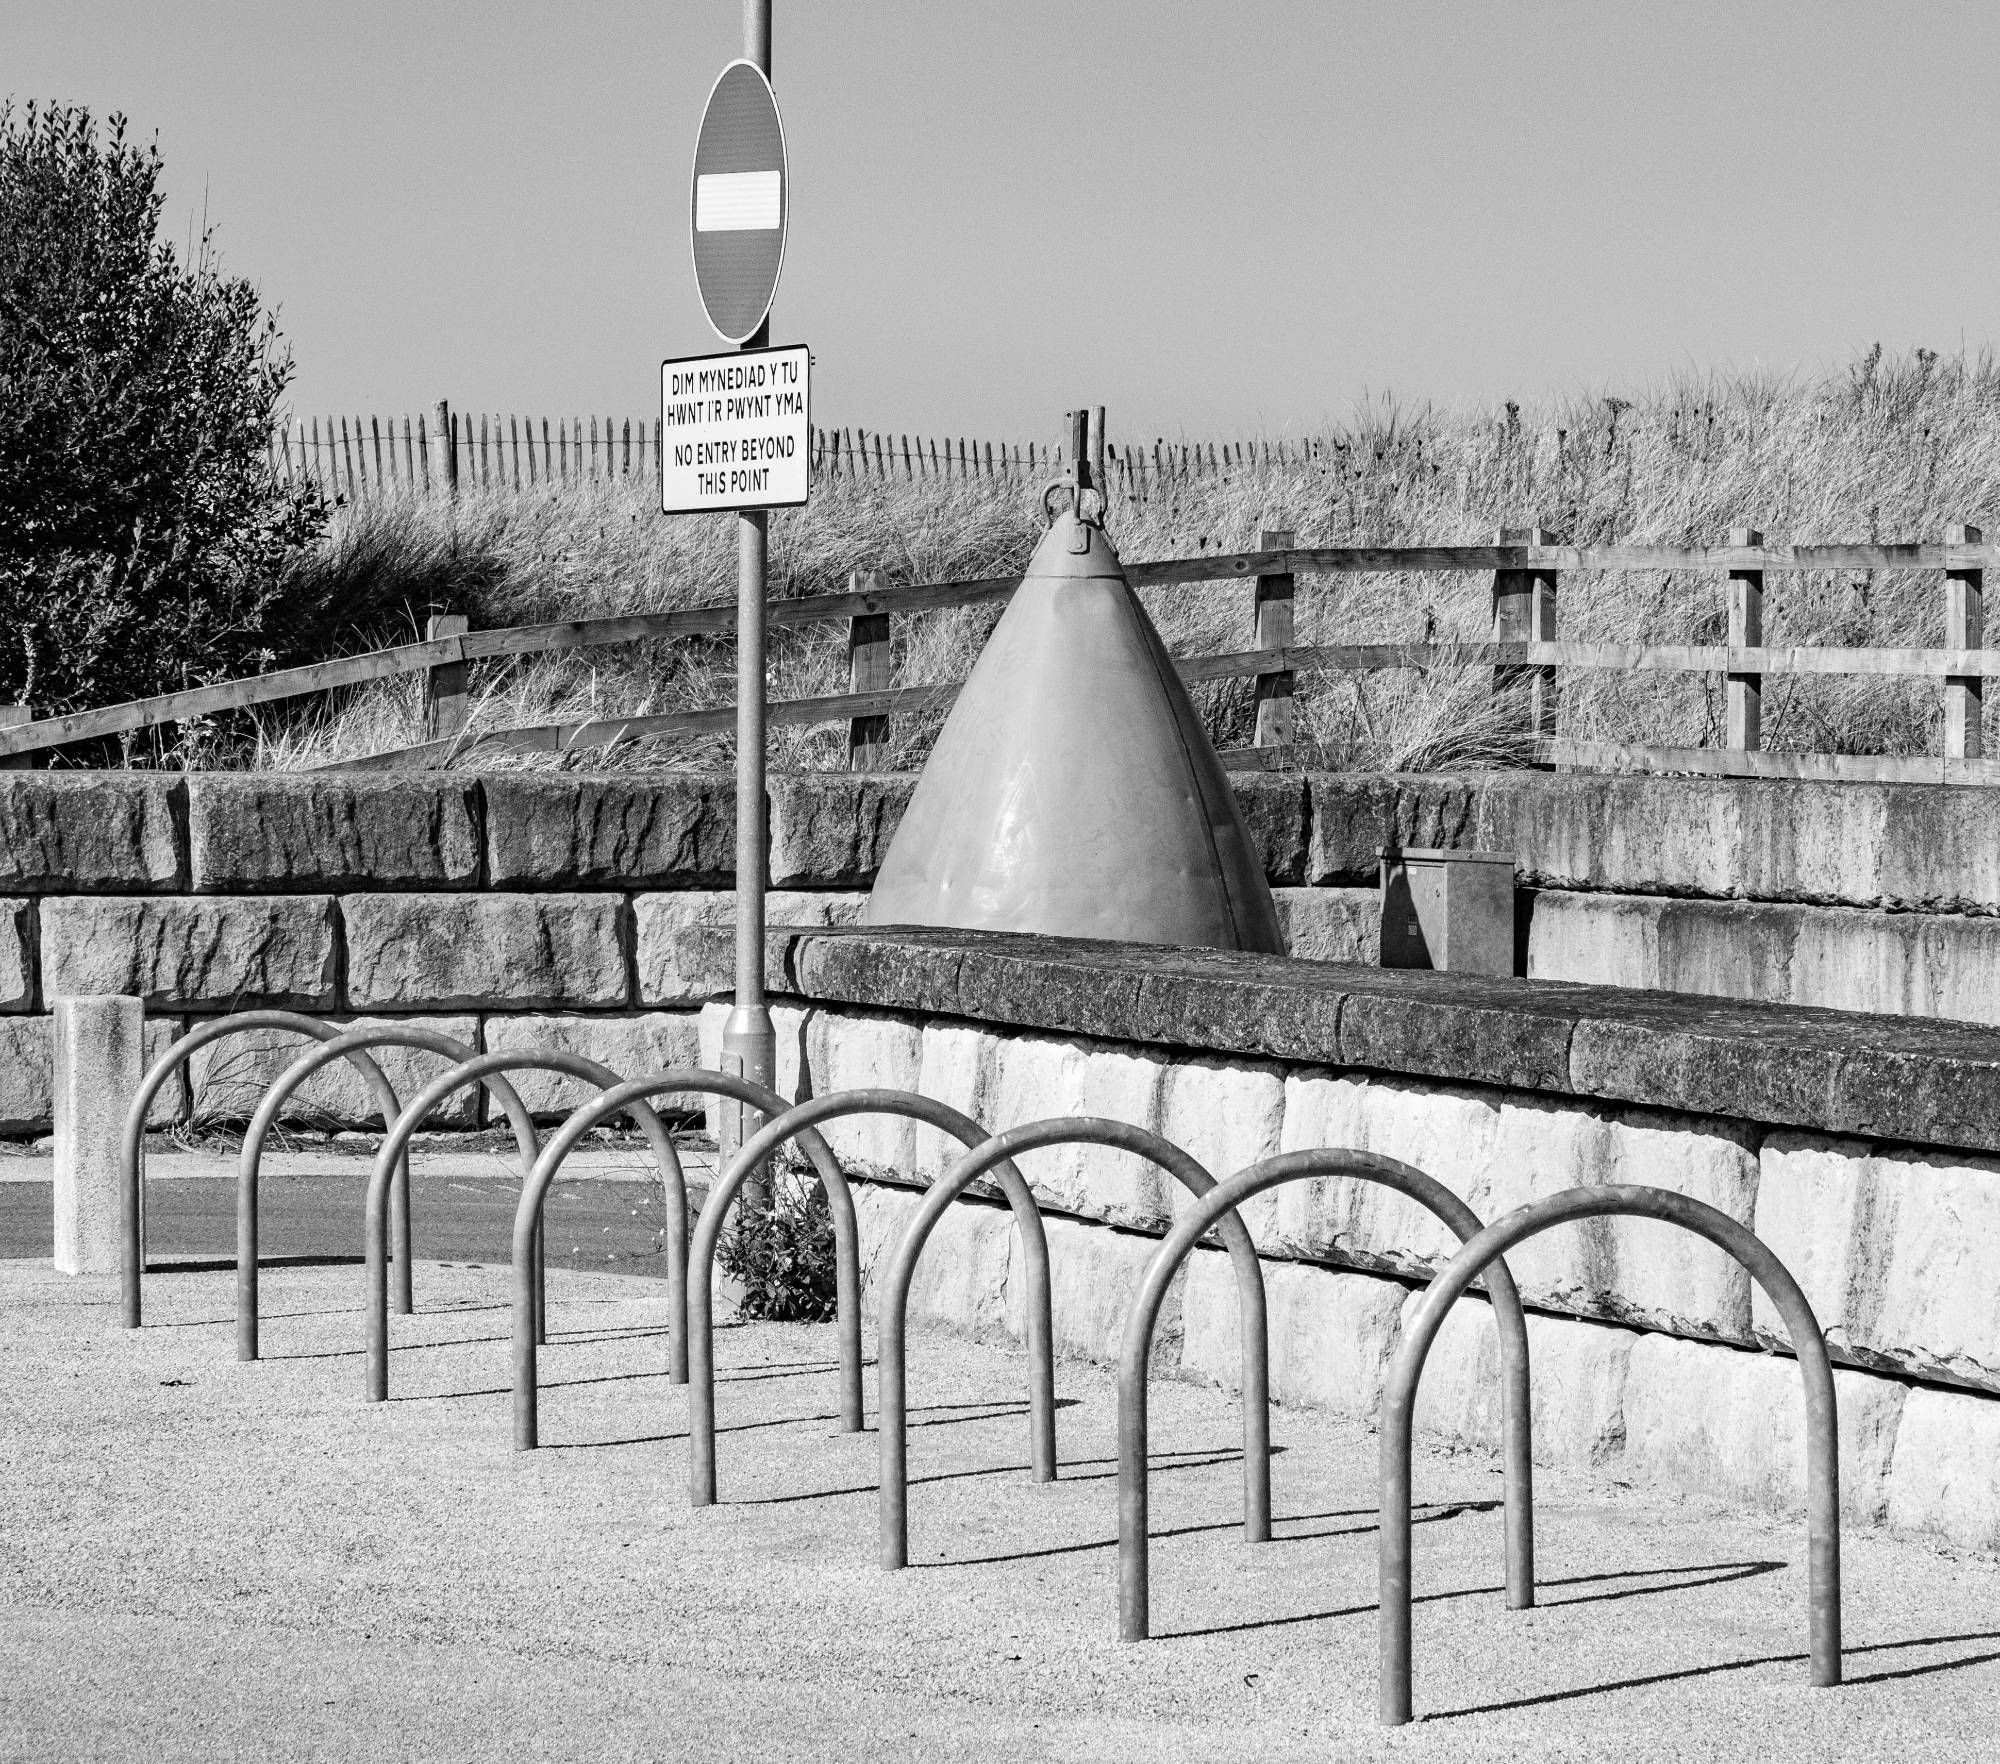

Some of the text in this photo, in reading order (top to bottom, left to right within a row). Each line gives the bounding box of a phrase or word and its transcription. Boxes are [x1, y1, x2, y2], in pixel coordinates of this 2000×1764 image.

[672, 361, 798, 396] DIM MYNEDIAD Y TU
[667, 392, 803, 426] HWNT I'R PWYNT YMA
[675, 435, 795, 467] NO ENTRY BEYOND
[697, 467, 770, 496] THIS POINT
